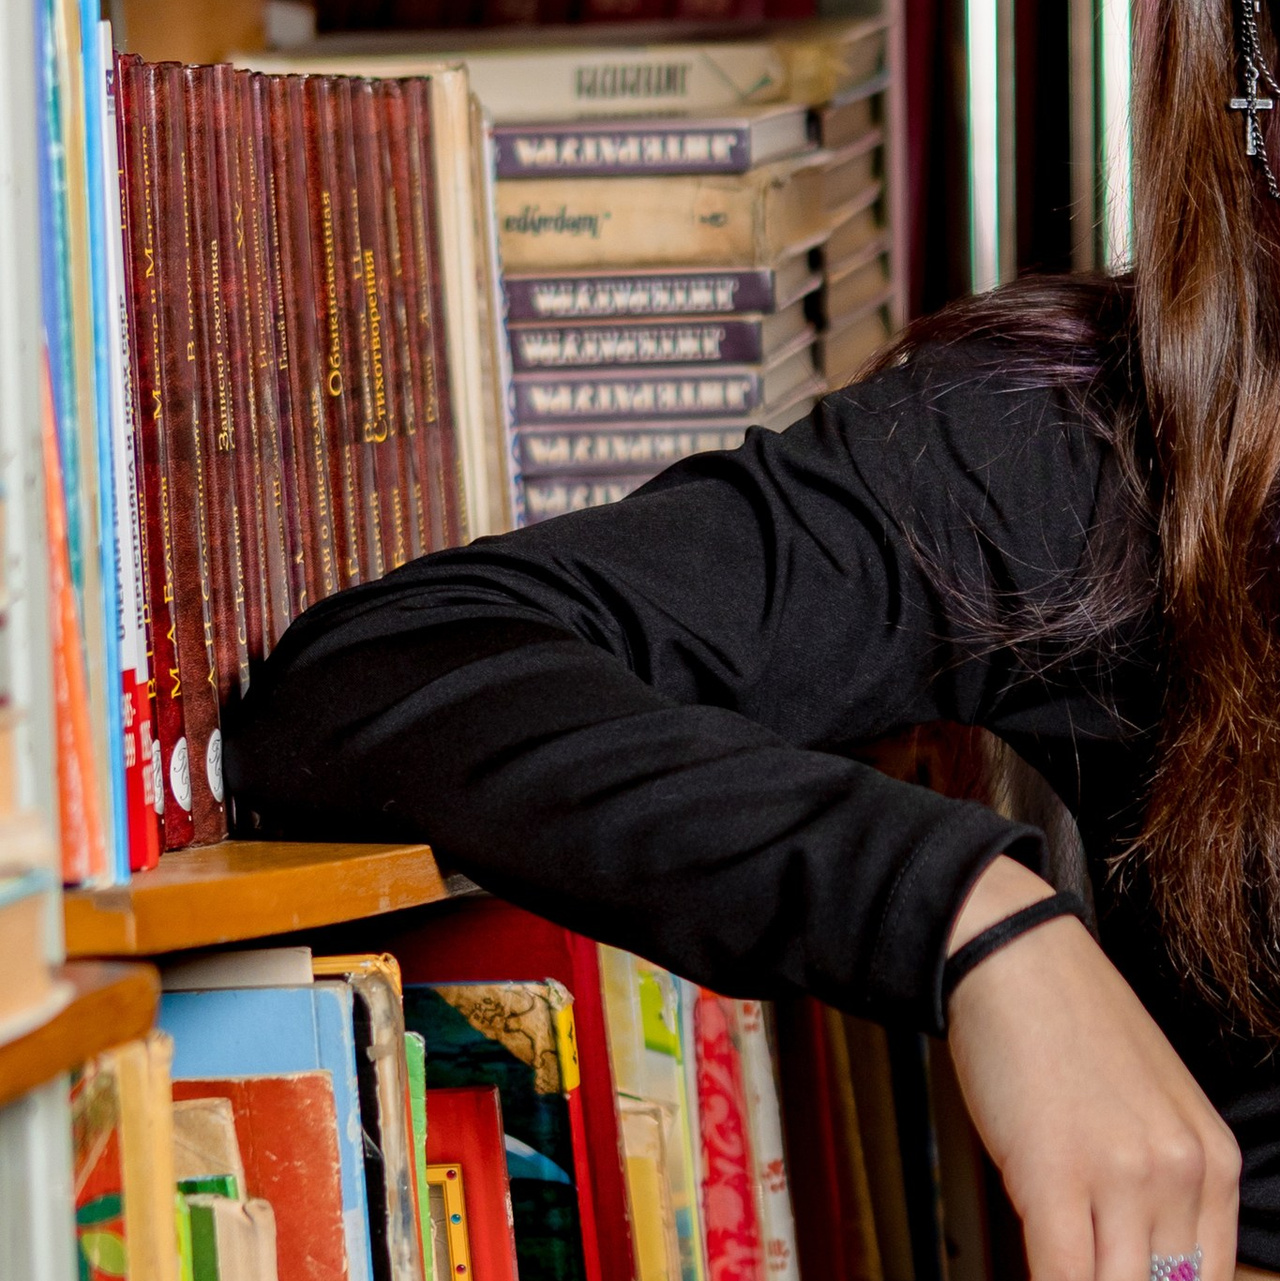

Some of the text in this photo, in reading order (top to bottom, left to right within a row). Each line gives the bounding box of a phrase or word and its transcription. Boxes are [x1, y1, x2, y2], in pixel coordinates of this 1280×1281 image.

[246, 136, 257, 202] города
[142, 124, 163, 421] Мастер и Маргарита
[251, 207, 261, 276] одного
[270, 172, 289, 371] Герой нашего времени
[322, 189, 344, 397] Обыкновенная
[118, 294, 128, 355] СССР
[210, 238, 230, 452] Записки охотника
[256, 282, 268, 370] История
[363, 249, 388, 443] Стихотворения
[520, 326, 726, 367] ЛИТЕРАТУРА
[533, 279, 740, 317] ЛИТЕРАТУРА
[122, 360, 131, 423] КРАХ
[187, 341, 196, 363] В
[359, 312, 374, 444] Рассказы
[530, 380, 751, 415] ЛИТЕРАТУРА
[126, 434, 133, 452] И
[310, 390, 327, 516] писателях
[127, 460, 145, 630] ПЕРЕСТРОЙКА
[161, 476, 175, 605] Булгаков
[233, 505, 245, 612] Тургенев
[344, 444, 359, 577] Гончаров
